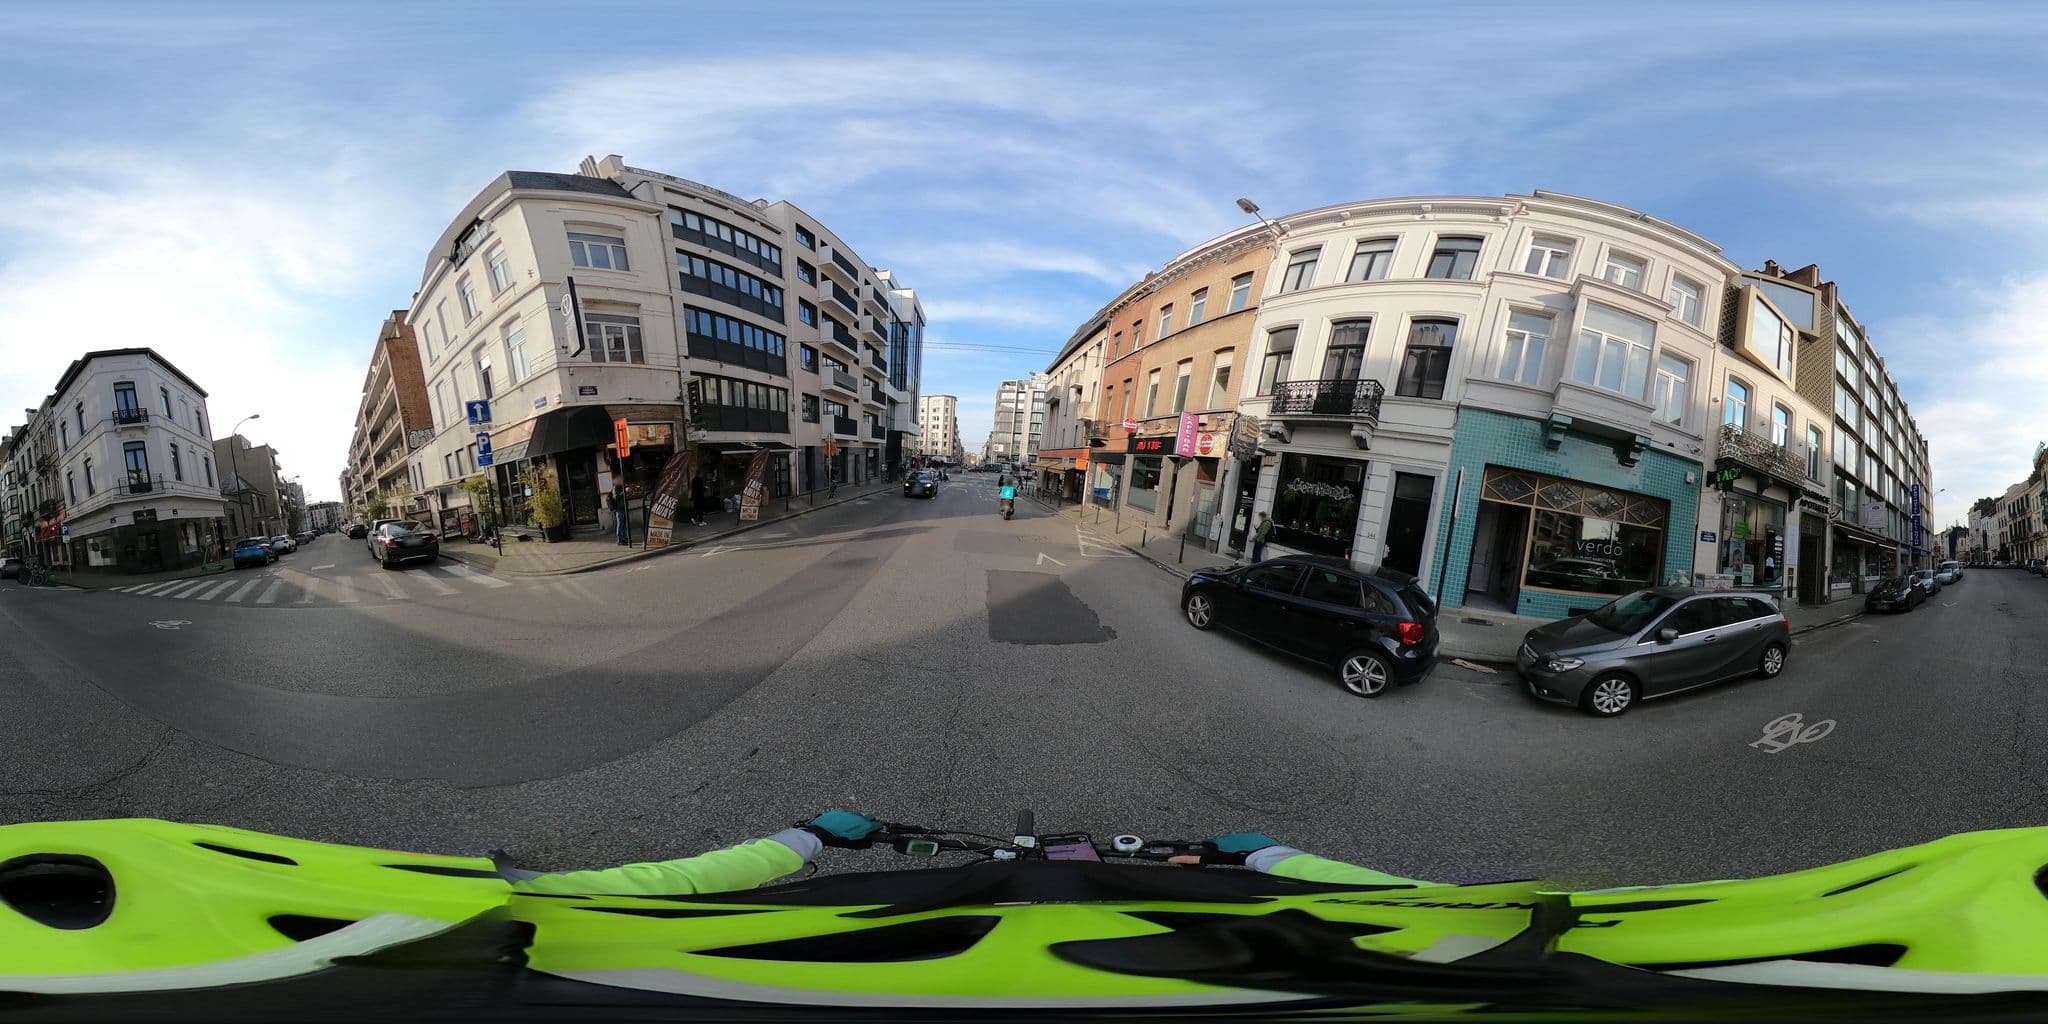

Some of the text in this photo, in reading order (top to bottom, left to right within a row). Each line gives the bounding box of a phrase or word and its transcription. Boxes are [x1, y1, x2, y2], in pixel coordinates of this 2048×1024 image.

[478, 435, 489, 451] P
[658, 493, 678, 510] TAKE
[650, 503, 675, 520] AWAY
